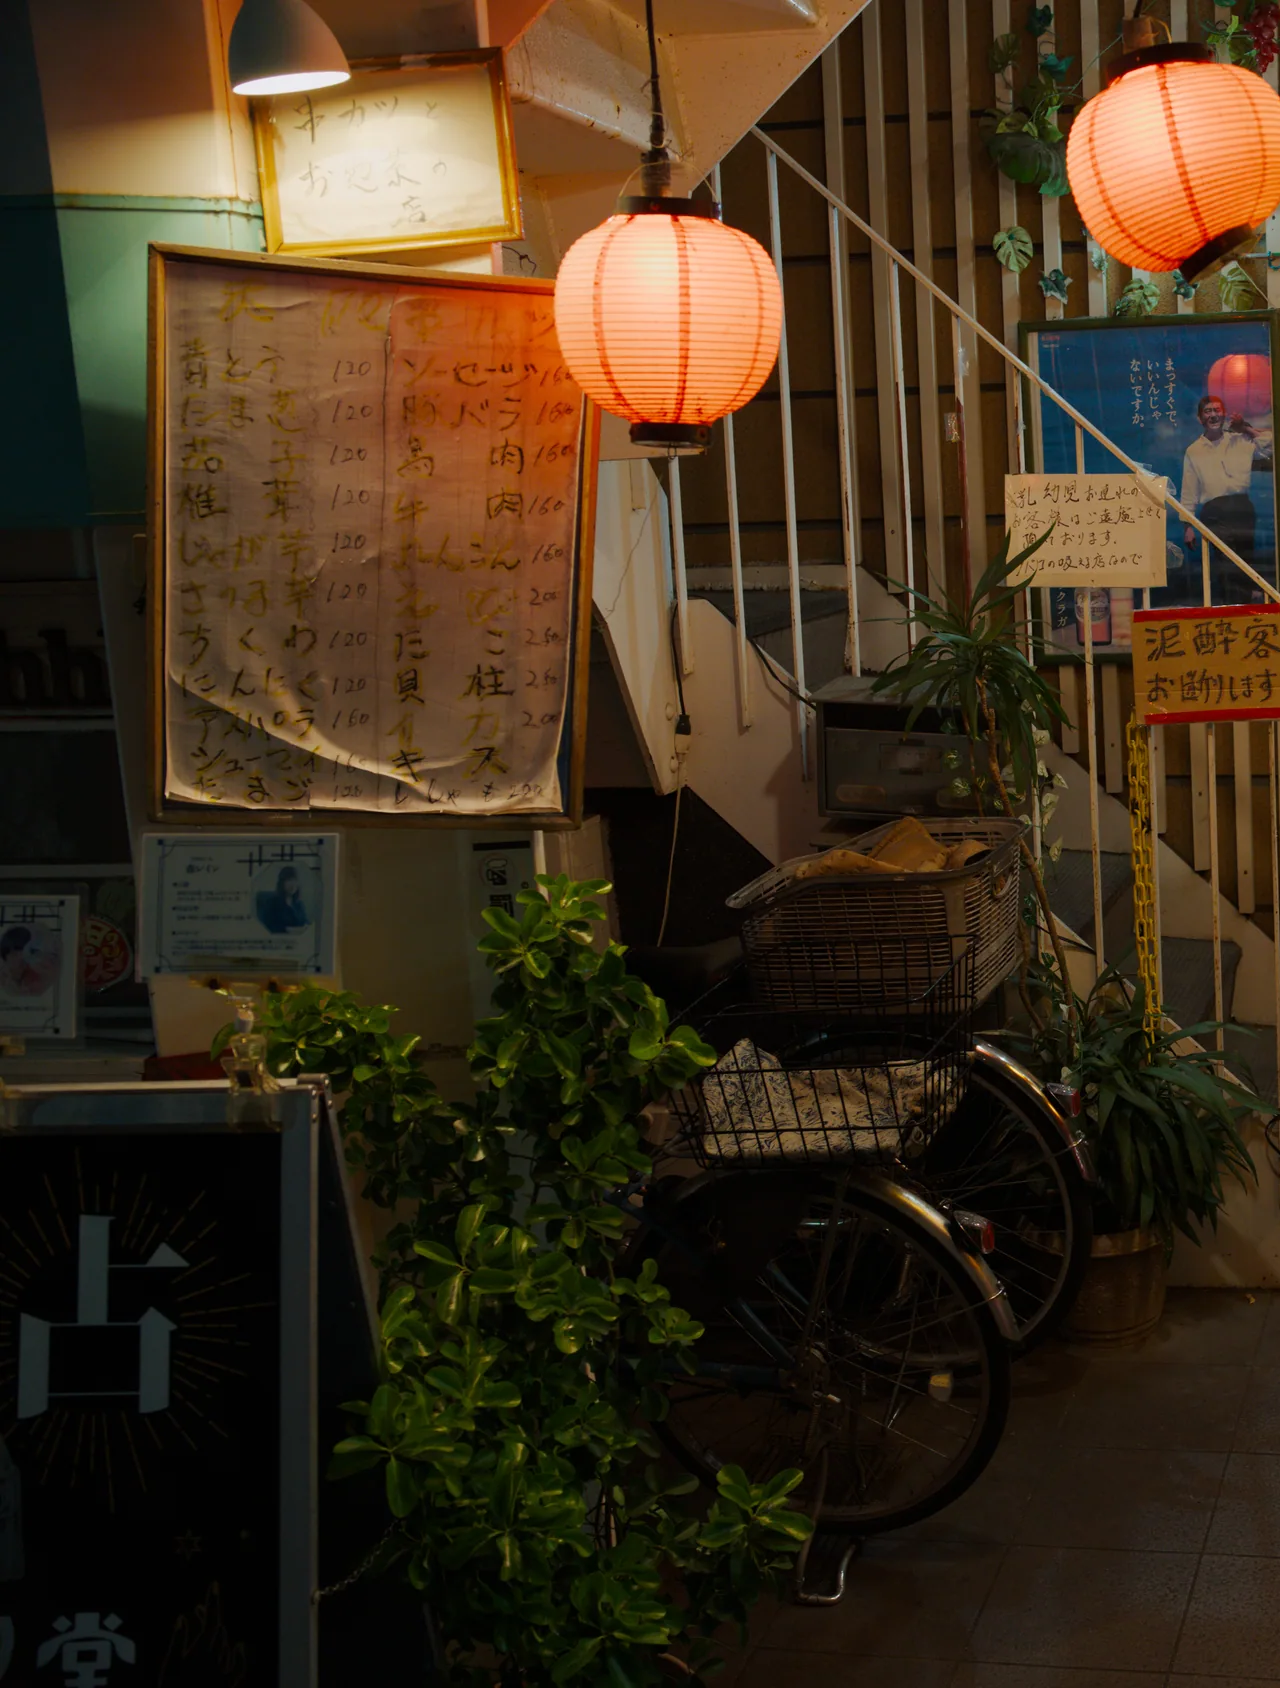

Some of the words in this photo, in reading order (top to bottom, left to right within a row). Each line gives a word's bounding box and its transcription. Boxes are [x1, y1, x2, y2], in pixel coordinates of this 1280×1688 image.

[1130, 357, 1145, 428] ないですか。
[1147, 358, 1161, 420] いいんじゃ
[1164, 356, 1179, 428] まっすぐで、
[332, 400, 373, 423] 120
[331, 484, 370, 510] 120
[528, 495, 565, 515] 160
[332, 532, 366, 553] 120
[326, 582, 367, 603] 120
[329, 630, 367, 649] 120
[1144, 618, 1280, 661] 泥酔客
[332, 677, 367, 695] 120
[1146, 668, 1278, 704] お断りします
